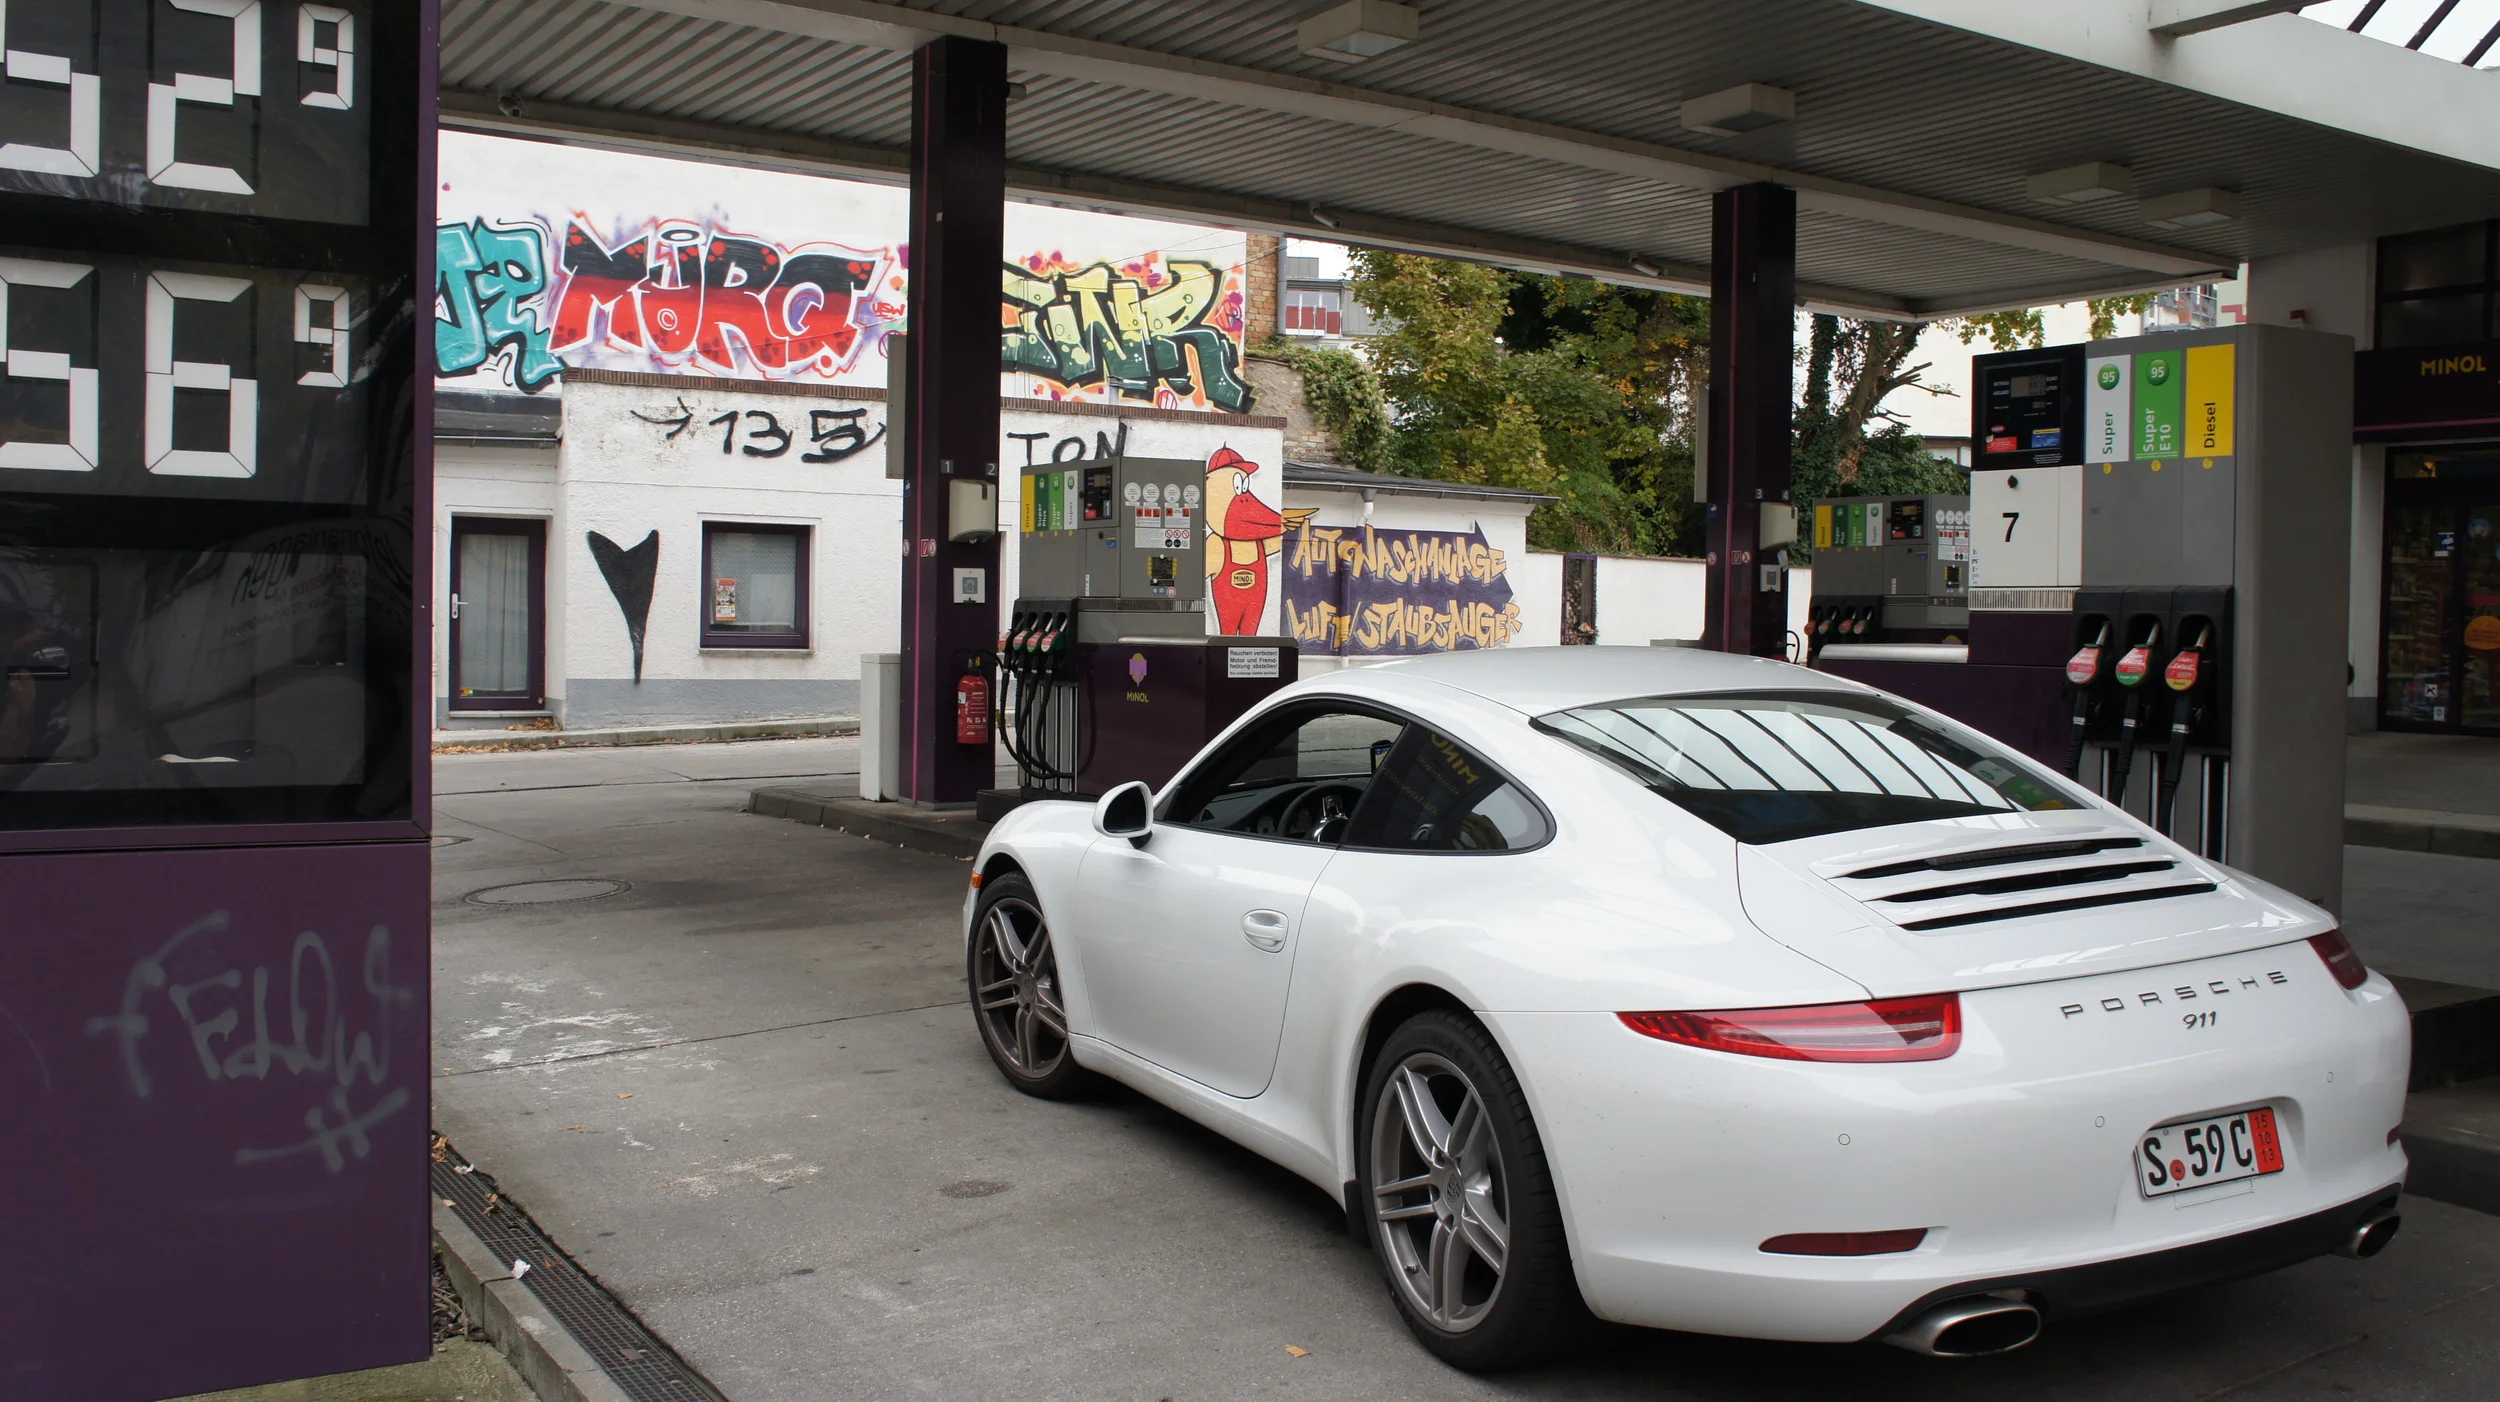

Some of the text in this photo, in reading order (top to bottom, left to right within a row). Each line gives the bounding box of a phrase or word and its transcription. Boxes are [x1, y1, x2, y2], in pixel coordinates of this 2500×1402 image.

[2150, 366, 2165, 379] 95
[2421, 355, 2486, 376] MINOL
[2102, 371, 2116, 384] 95
[2103, 411, 2114, 455] Super
[2143, 408, 2157, 452] Super
[2204, 402, 2216, 449] Diesel
[2159, 424, 2172, 452] E10
[2002, 512, 2019, 542] 7
[1126, 691, 1149, 703] MINOL
[2059, 970, 2288, 1019] PORSCHE
[2182, 1011, 2217, 1029] 911
[2255, 1115, 2268, 1128] 15
[2258, 1132, 2272, 1145] 10
[2261, 1148, 2275, 1163] 13
